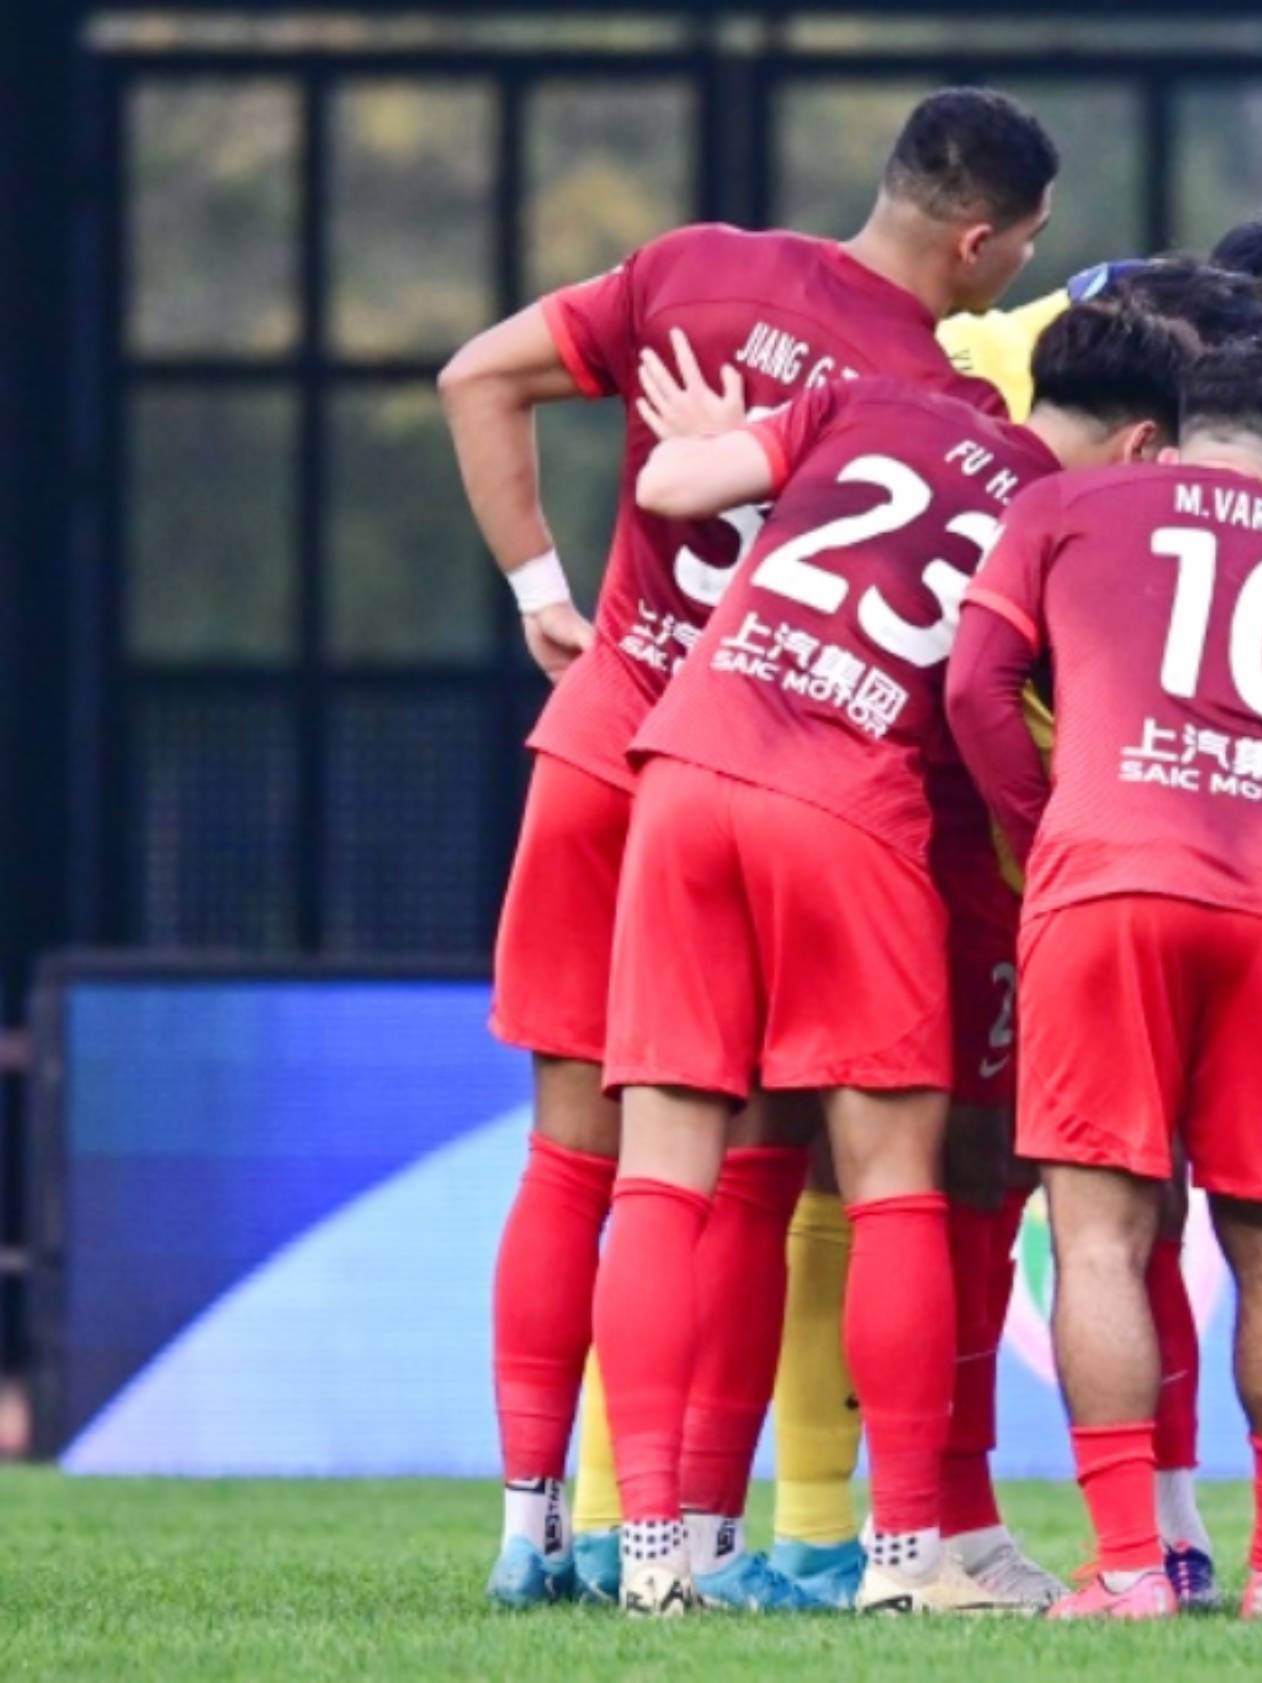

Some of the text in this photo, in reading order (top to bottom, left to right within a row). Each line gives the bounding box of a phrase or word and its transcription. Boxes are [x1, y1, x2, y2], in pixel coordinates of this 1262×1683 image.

[736, 320, 809, 384] JIANG
[944, 439, 994, 475] FU
[749, 454, 1006, 668] 23
[711, 650, 888, 739] SAIC MOTOR
[720, 612, 908, 725] 上汽集团
[1119, 760, 1201, 792] SAIC
